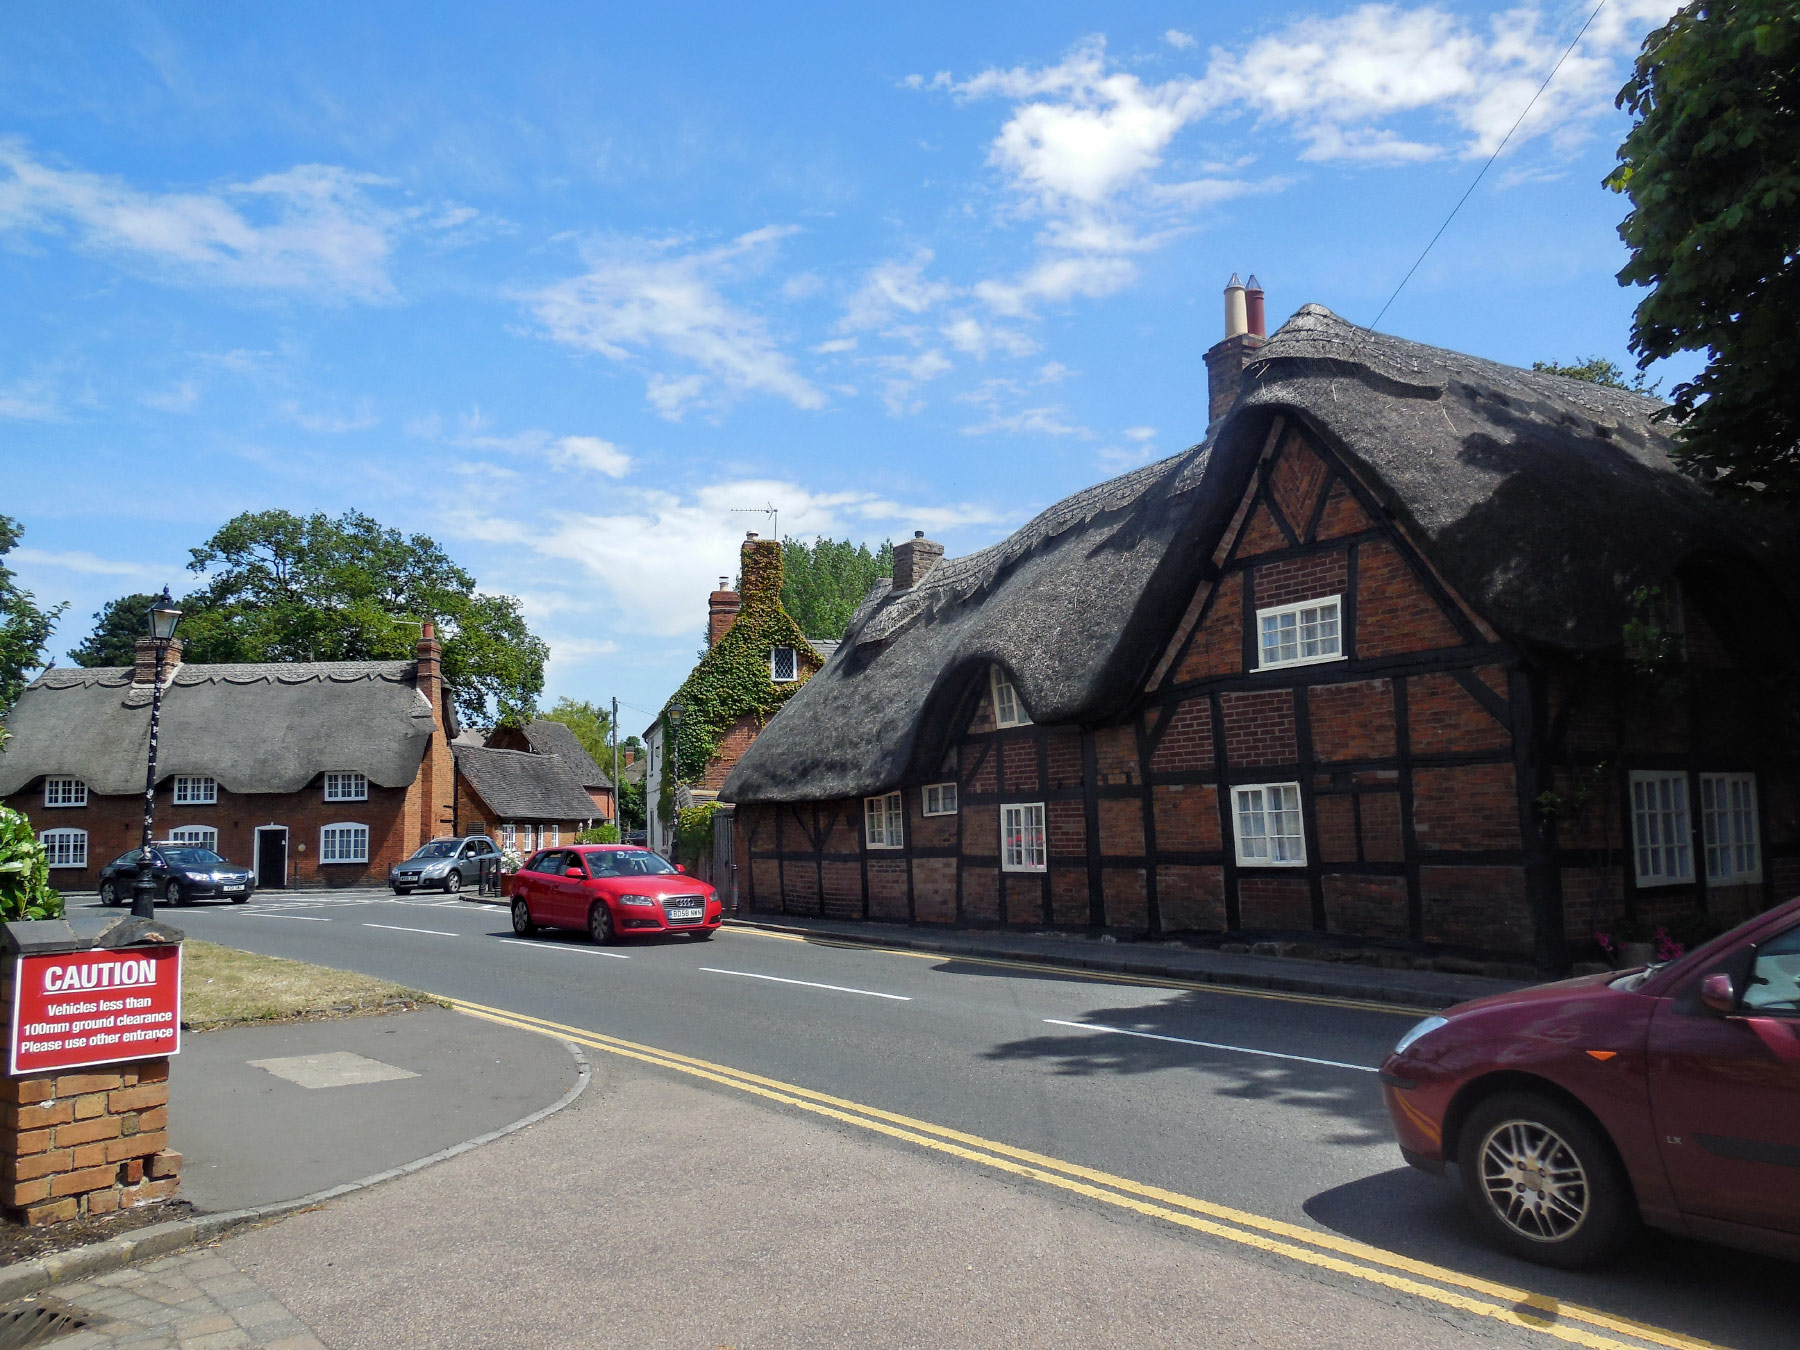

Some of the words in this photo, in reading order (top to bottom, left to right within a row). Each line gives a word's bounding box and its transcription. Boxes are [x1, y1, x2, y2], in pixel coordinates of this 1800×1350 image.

[45, 959, 157, 991] CAUTION
[48, 1002, 97, 1016] Vehicles
[100, 1000, 123, 1010] less
[126, 997, 152, 1009] than
[24, 1023, 69, 1036] 100mm
[72, 1016, 114, 1033] ground
[117, 1012, 173, 1026] clearance
[21, 1040, 62, 1054] Please
[65, 1037, 86, 1048] use
[89, 1033, 120, 1046] other
[123, 1027, 174, 1042] entrance
